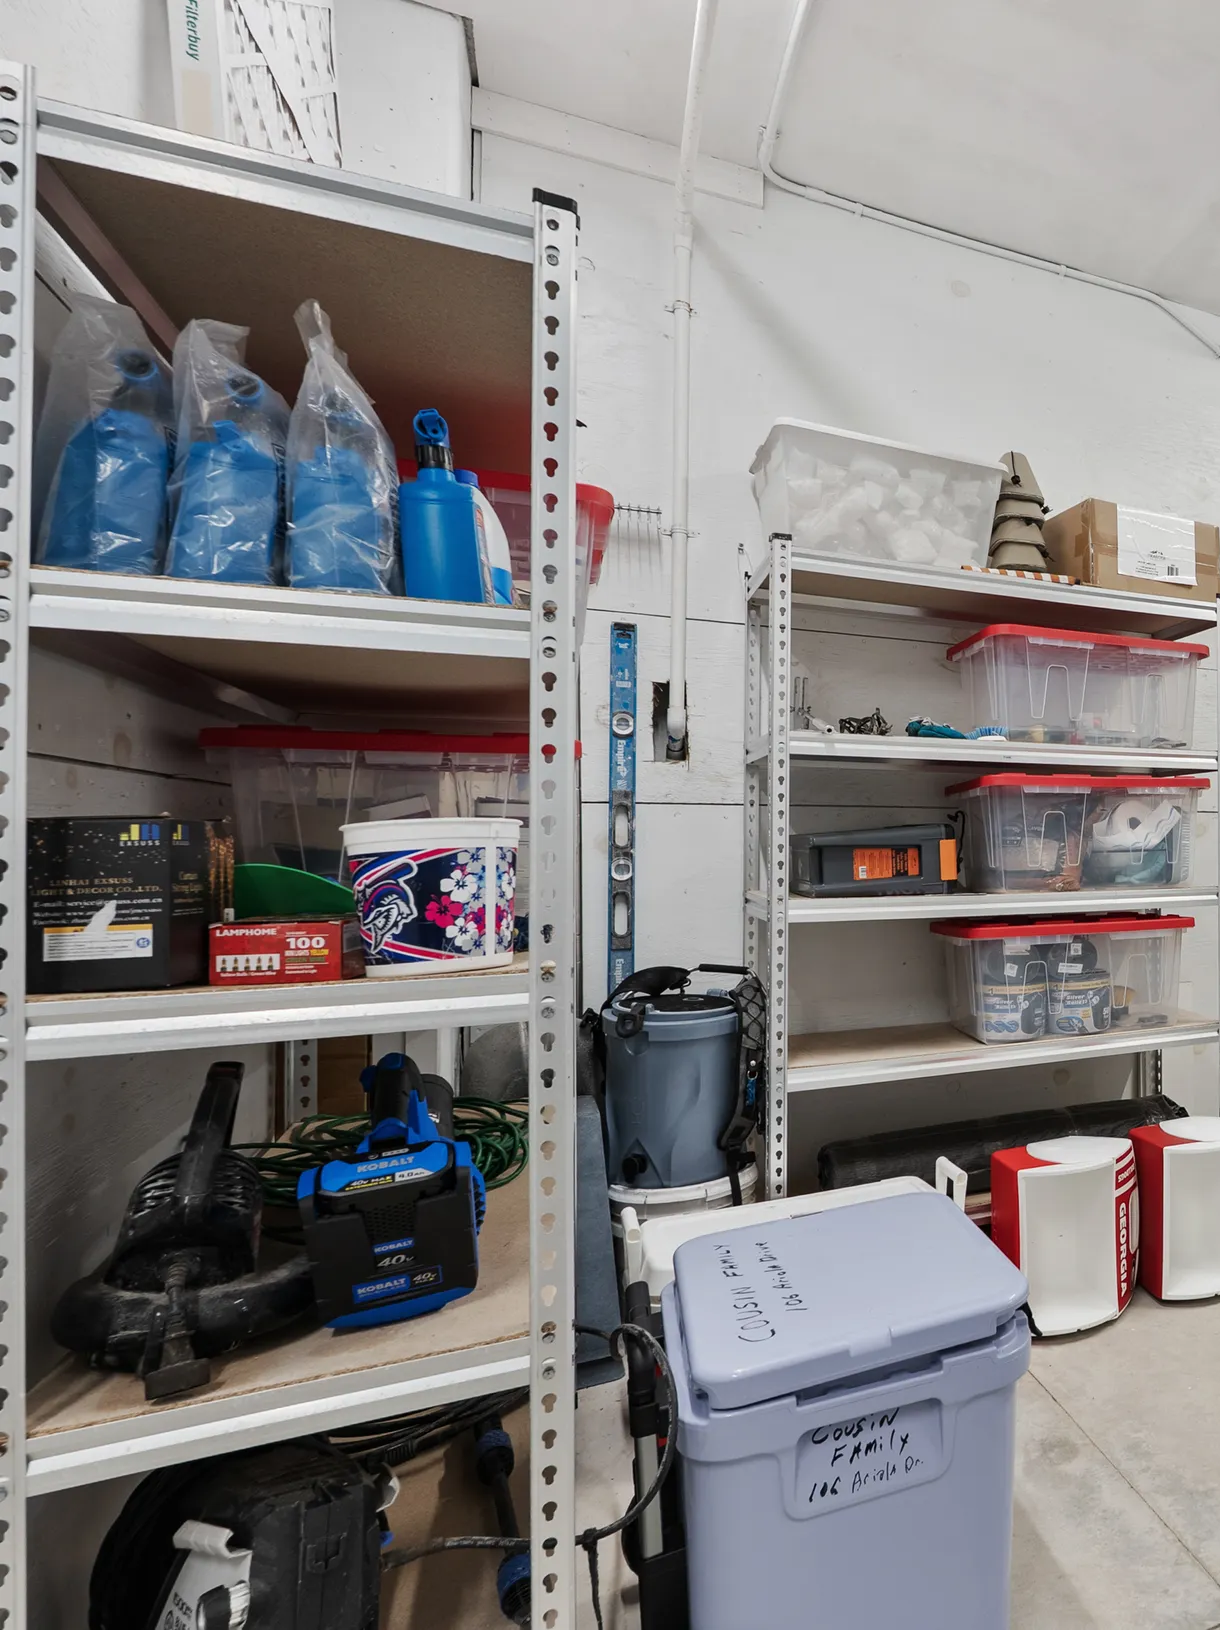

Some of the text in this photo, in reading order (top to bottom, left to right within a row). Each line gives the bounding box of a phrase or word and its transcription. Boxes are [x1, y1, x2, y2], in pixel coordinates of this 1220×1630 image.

[616, 739, 628, 773] Empire
[76, 886, 113, 895] DECOR
[216, 928, 277, 937] LAMPHOME
[286, 937, 326, 949] 100
[356, 1156, 415, 1173] KOBALT
[374, 1239, 413, 1253] KOBALT
[1119, 1202, 1128, 1298] GEORGIA
[357, 1278, 406, 1295] KOBALT
[713, 1244, 776, 1342] COUSIN FAMILY
[781, 1293, 809, 1312] 106
[808, 1476, 841, 1503] 106
